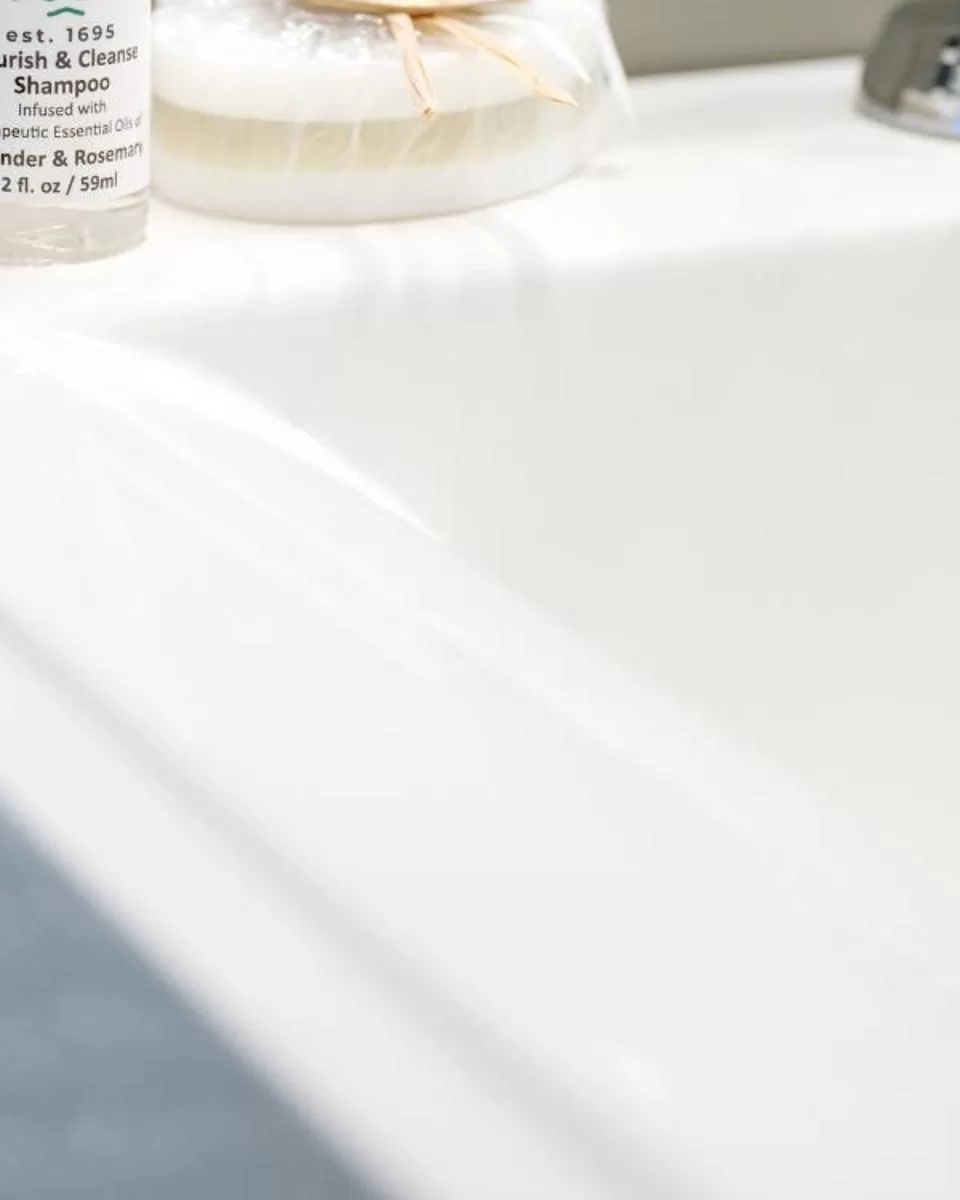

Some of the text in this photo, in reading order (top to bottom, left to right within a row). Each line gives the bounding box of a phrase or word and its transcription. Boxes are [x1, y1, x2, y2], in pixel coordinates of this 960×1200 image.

[6, 24, 115, 43] est. 1695
[55, 50, 72, 69] &
[78, 46, 139, 67] Cleanse
[14, 75, 110, 97] Shampoo
[18, 99, 107, 117] Infused with
[54, 120, 113, 139] Essential
[52, 150, 68, 167] &
[1, 172, 118, 195] 2 fl. oz / 59ml
